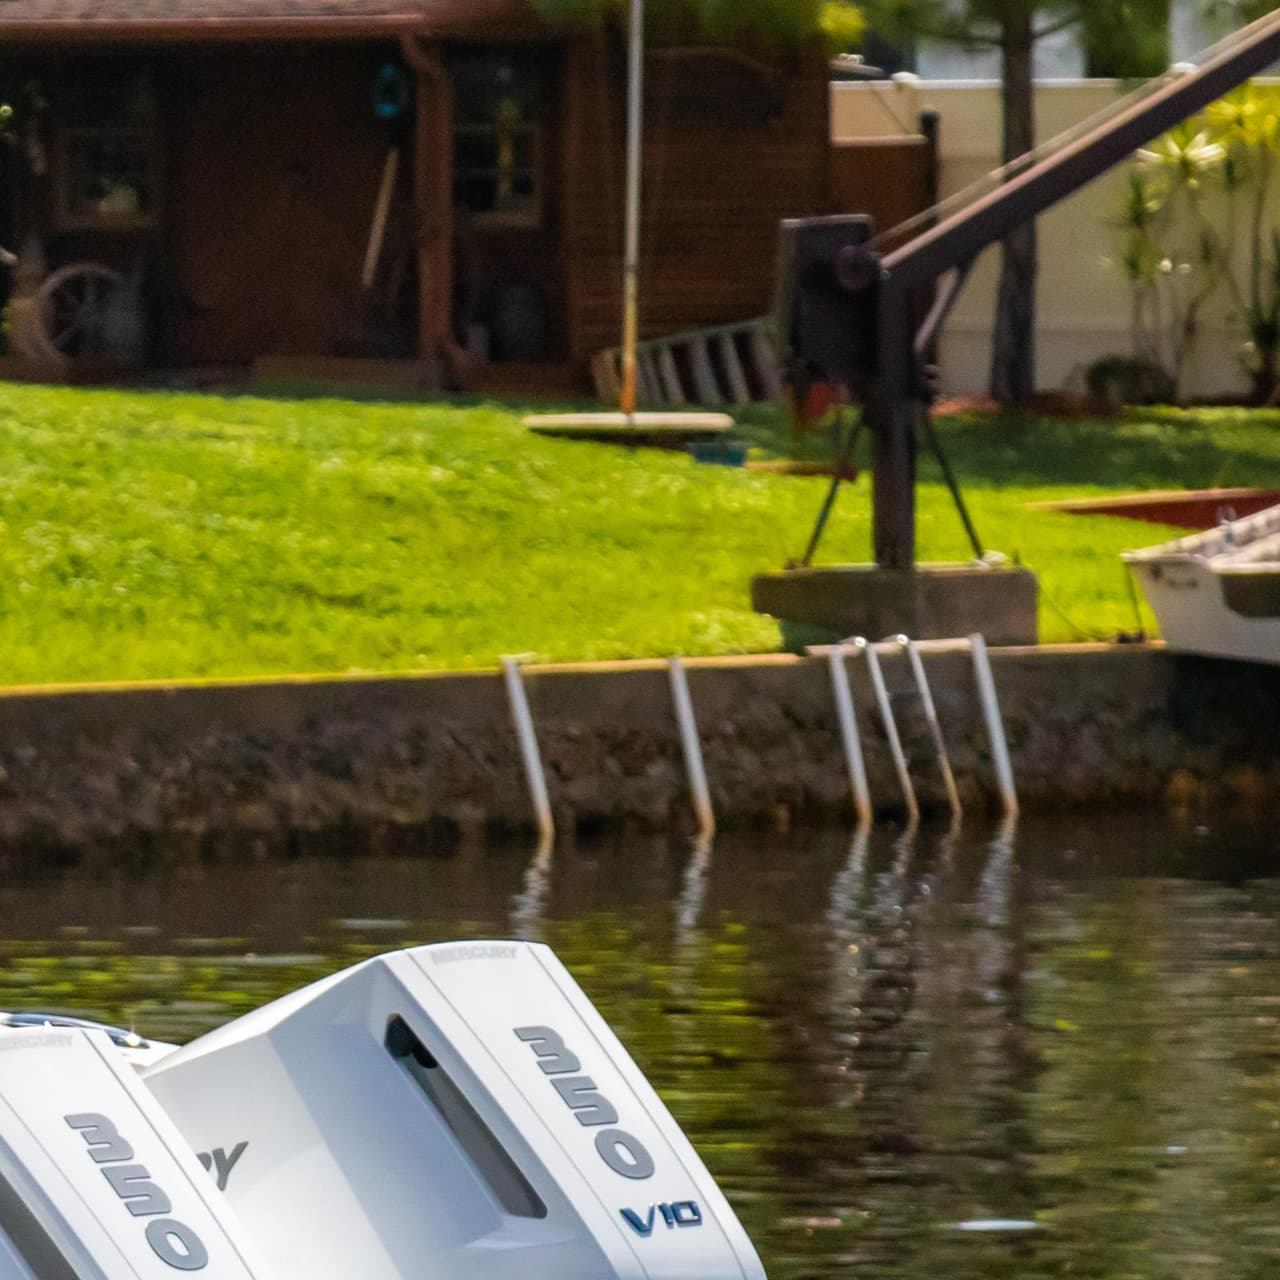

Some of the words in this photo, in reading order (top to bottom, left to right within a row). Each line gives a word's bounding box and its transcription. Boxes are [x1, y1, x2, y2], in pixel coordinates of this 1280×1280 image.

[512, 1025, 655, 1180] 350
[63, 1112, 209, 1272] 350
[619, 1200, 702, 1238] V10
